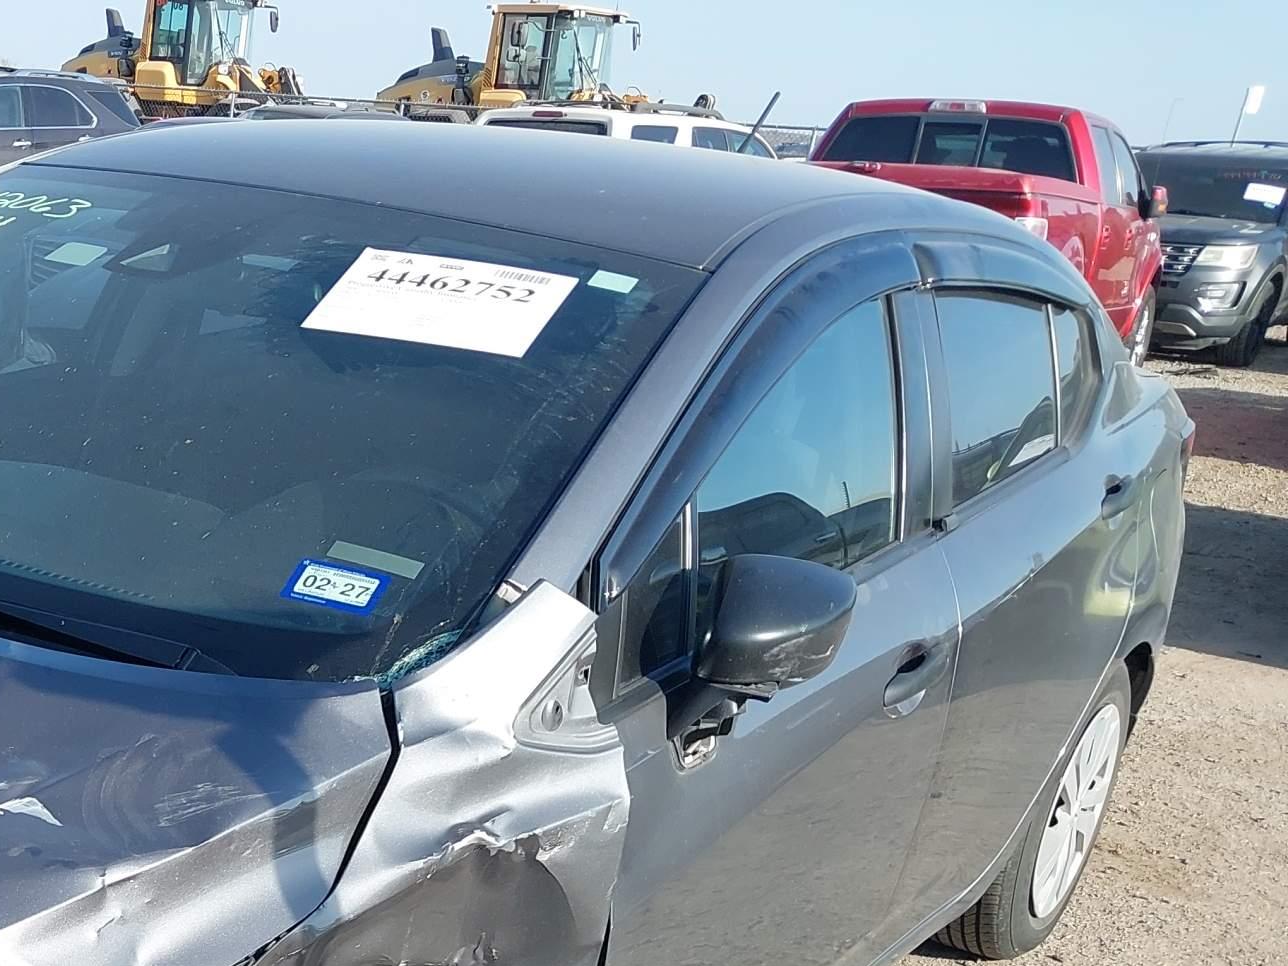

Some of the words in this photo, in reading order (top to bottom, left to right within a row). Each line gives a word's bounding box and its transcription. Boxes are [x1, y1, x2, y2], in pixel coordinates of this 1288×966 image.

[367, 267, 536, 303] 44462752
[302, 574, 332, 592] 02
[339, 582, 372, 599] 27
